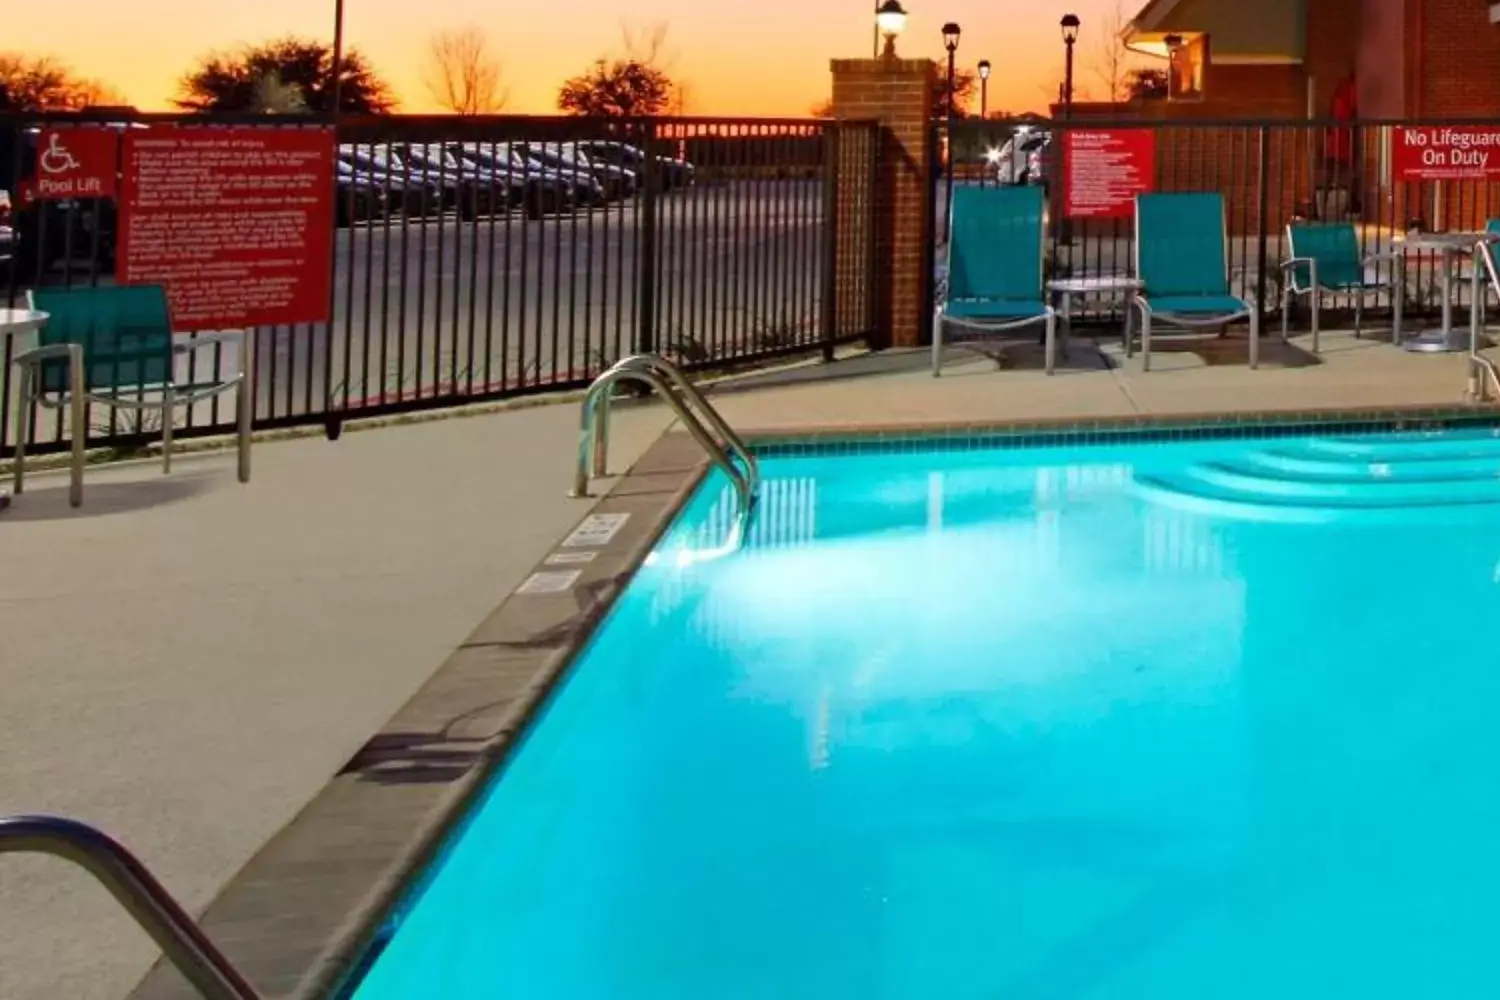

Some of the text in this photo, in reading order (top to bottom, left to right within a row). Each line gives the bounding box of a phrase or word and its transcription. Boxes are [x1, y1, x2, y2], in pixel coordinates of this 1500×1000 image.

[1404, 129, 1427, 146] No
[1422, 148, 1489, 168] On Duty
[40, 176, 100, 193] Pool Lift
